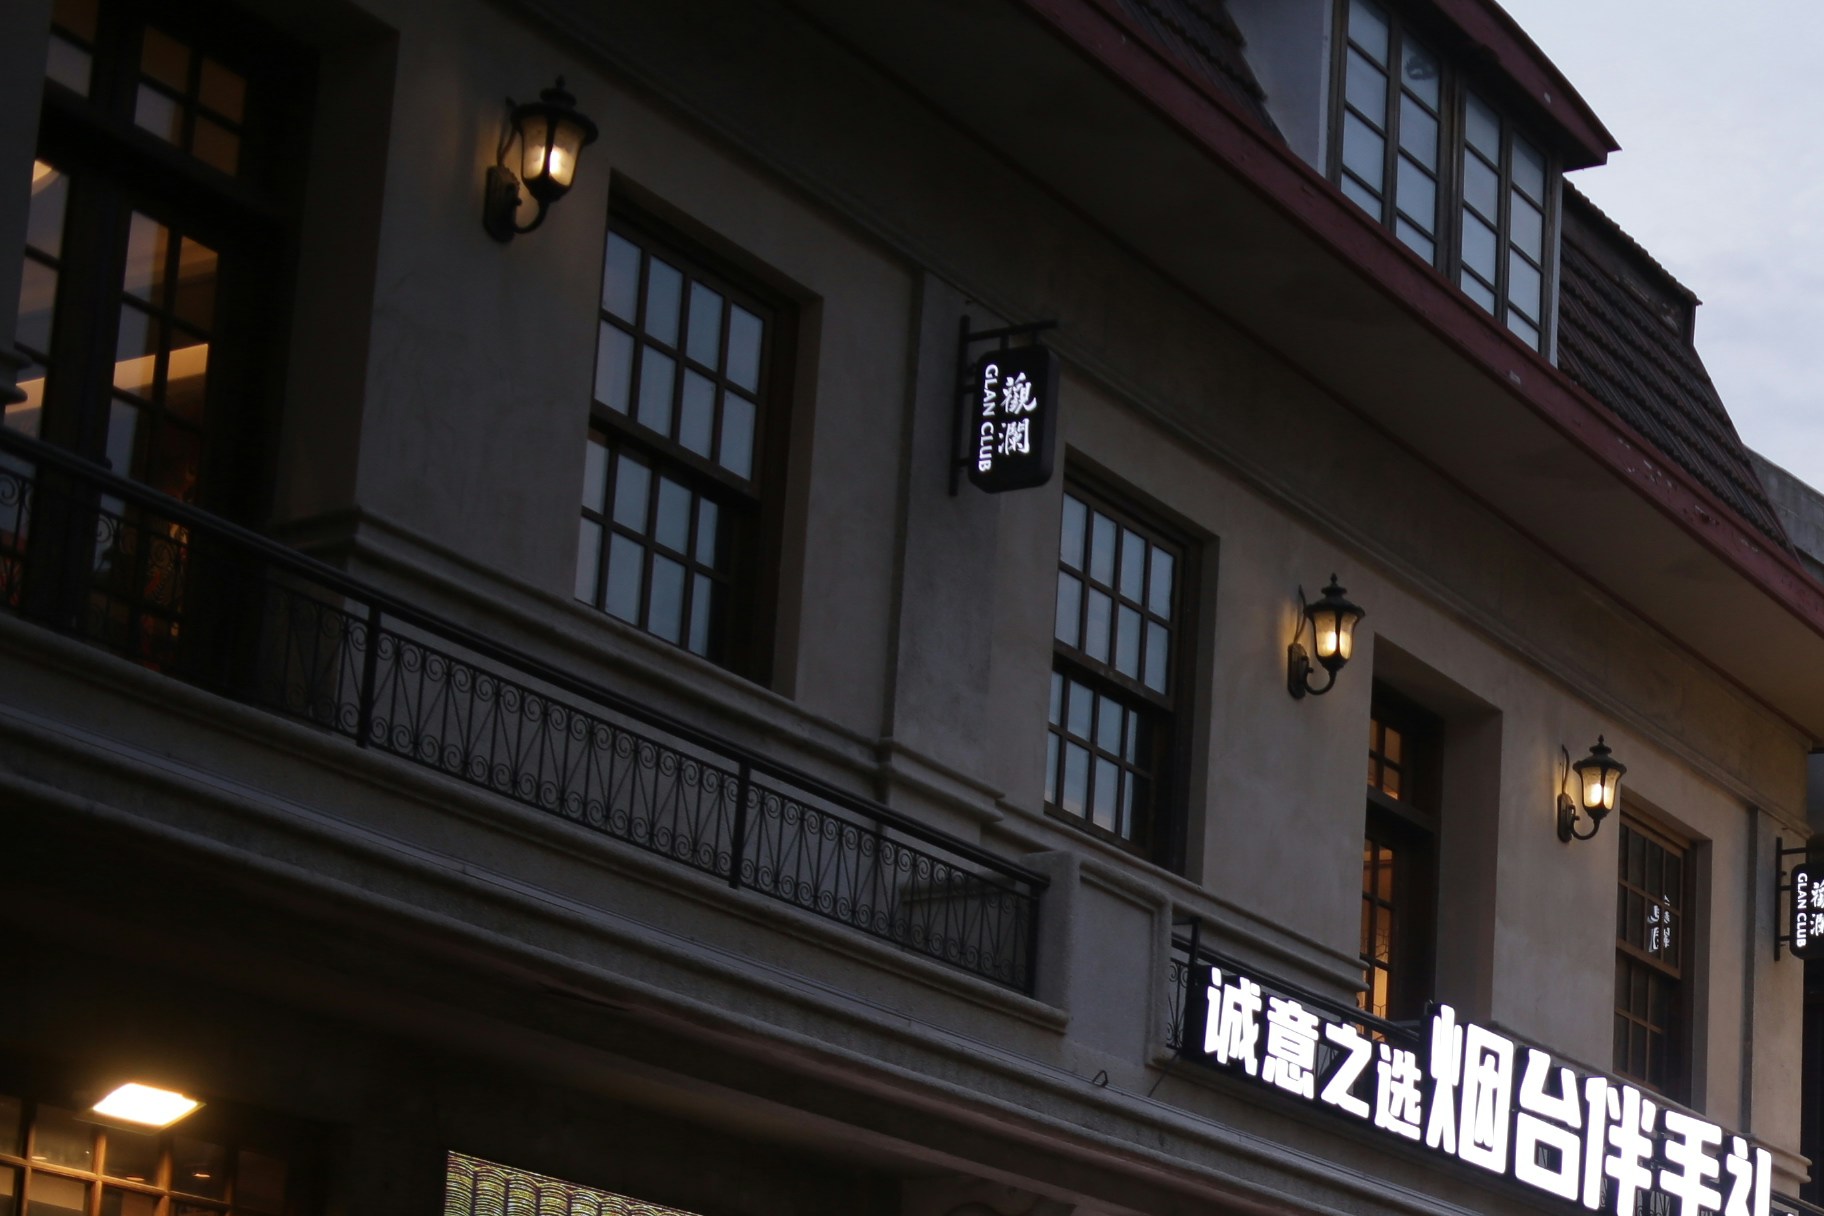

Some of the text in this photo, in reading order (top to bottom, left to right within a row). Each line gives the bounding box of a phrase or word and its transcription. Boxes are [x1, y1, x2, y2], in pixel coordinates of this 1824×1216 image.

[978, 363, 999, 472] GLAN CLUB
[997, 372, 1038, 456] 觀瀾
[1796, 872, 1808, 948] GLAN CLUB
[1204, 967, 1423, 1142] 诚意之选
